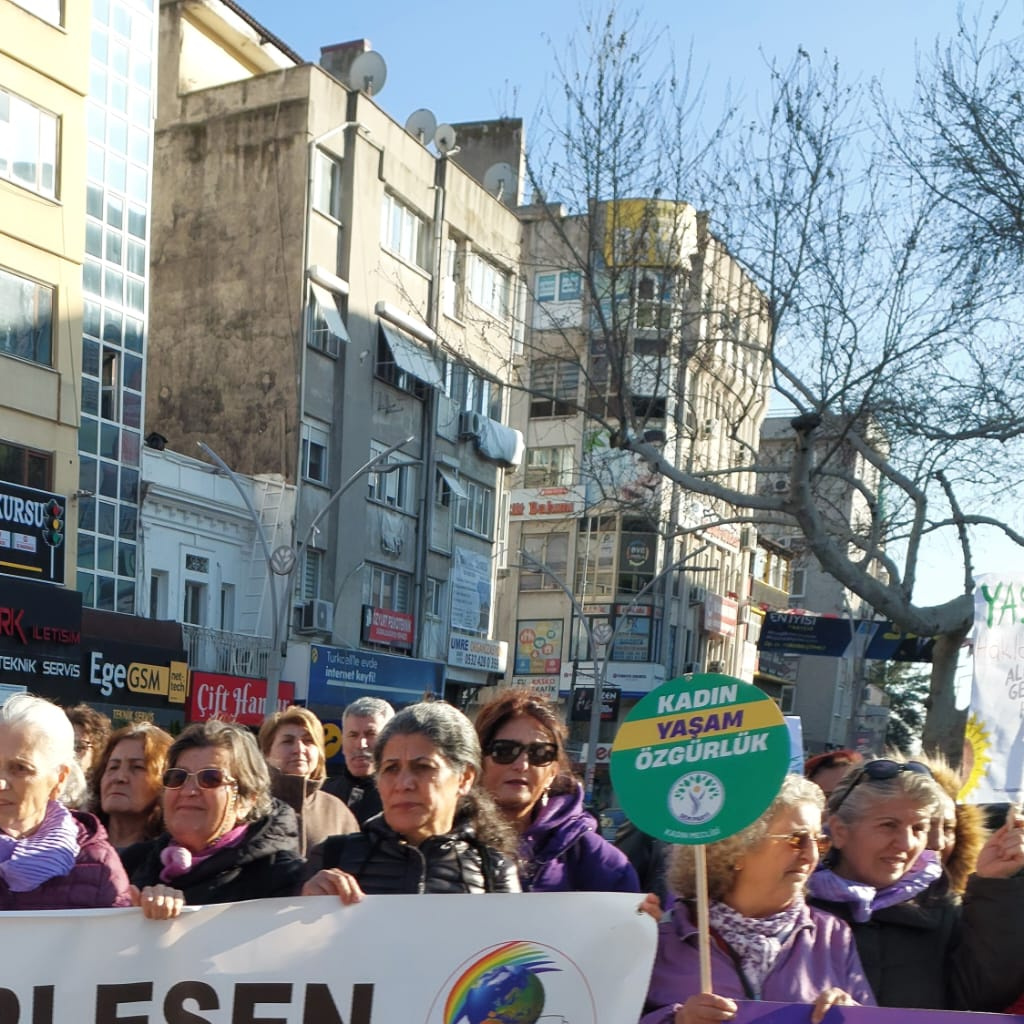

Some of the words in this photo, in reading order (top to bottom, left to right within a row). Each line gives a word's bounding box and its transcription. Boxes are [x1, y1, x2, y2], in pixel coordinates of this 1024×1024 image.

[90, 651, 127, 697] Ege
[129, 666, 161, 691] GSM
[171, 681, 185, 692] tech
[326, 665, 355, 680] internet
[197, 683, 230, 718] Çift
[657, 684, 738, 714] KADIN
[657, 709, 744, 740] YAŞAM
[635, 731, 770, 771] ÖZGÜRLÜK
